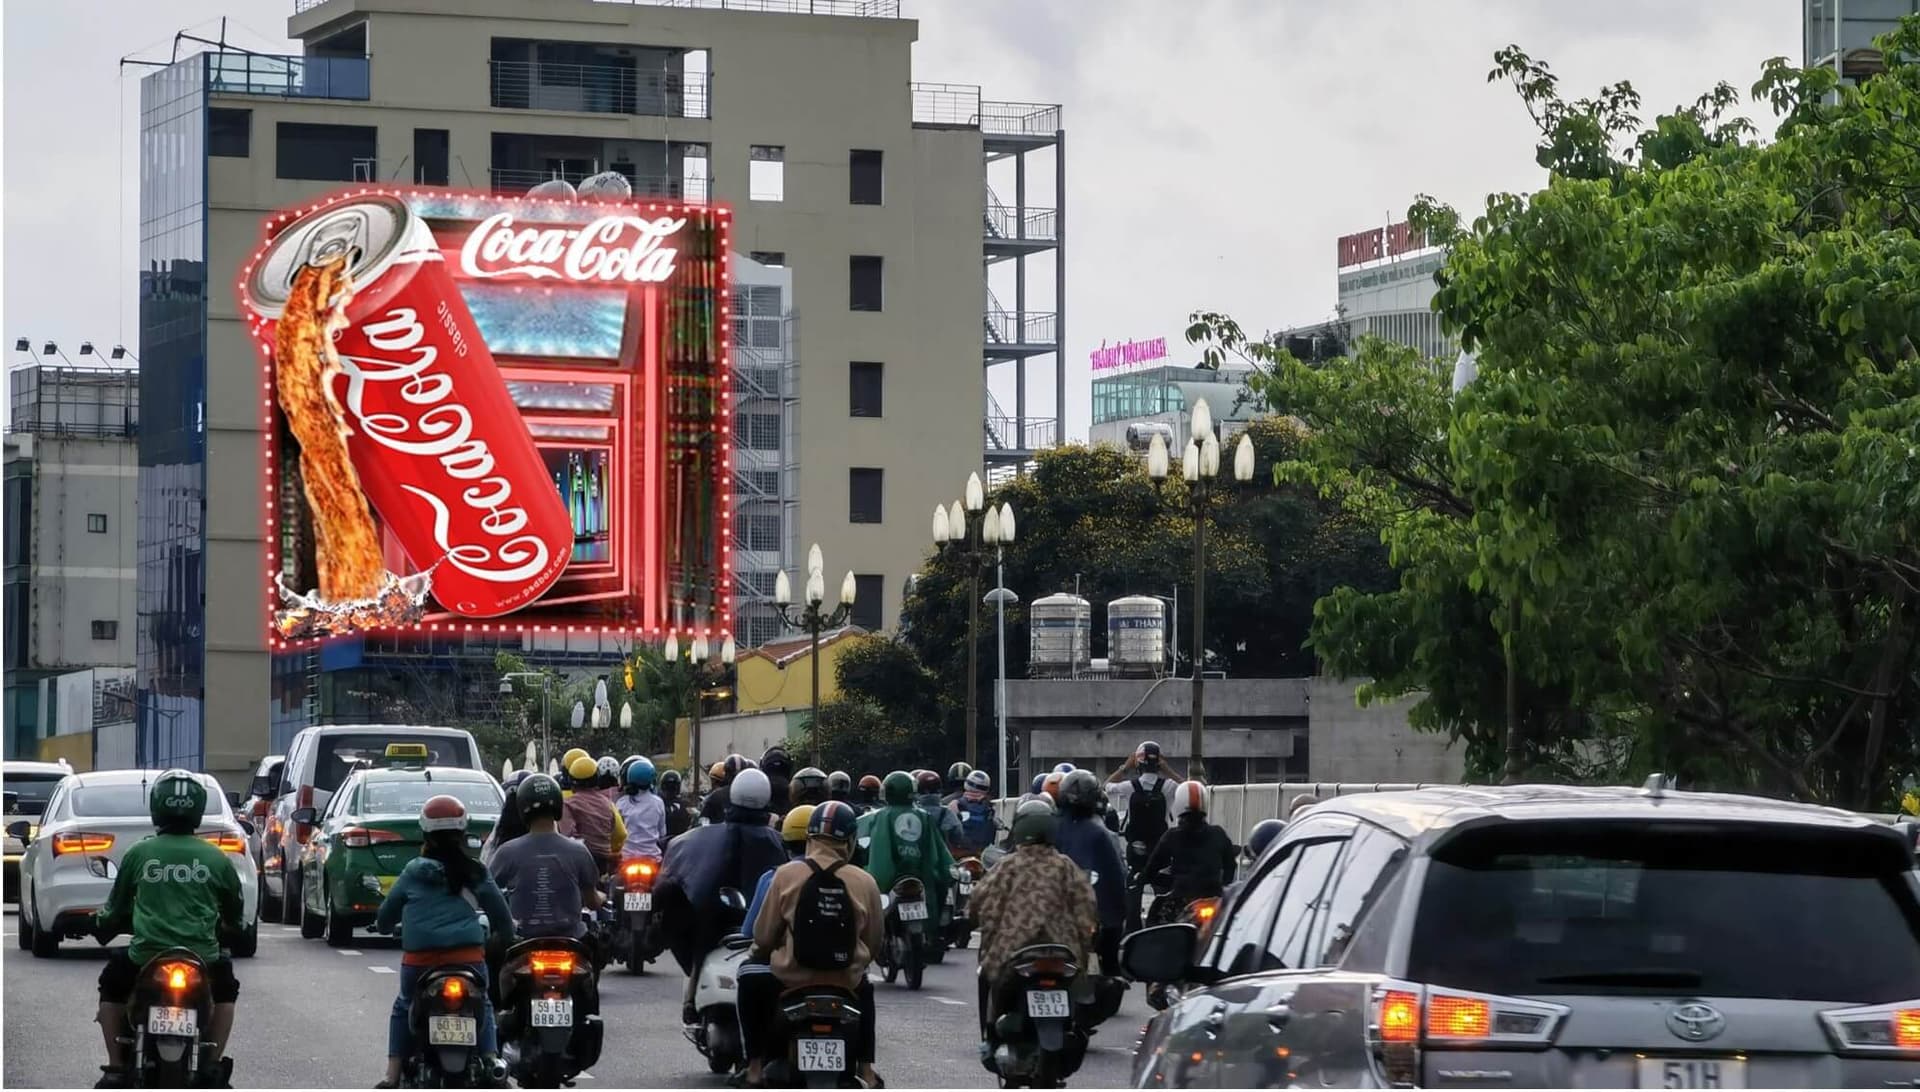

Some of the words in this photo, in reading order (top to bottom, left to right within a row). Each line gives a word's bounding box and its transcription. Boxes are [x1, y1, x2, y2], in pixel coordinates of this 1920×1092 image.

[460, 212, 686, 282] Coca-Cola
[437, 300, 467, 357] classic
[165, 796, 195, 808] Grab
[143, 859, 210, 884] Grab
[534, 1013, 570, 1025] 888.29
[805, 1041, 838, 1055] 59-G2
[801, 1055, 842, 1069] 174.58
[1663, 1062, 1721, 1089] 51H
